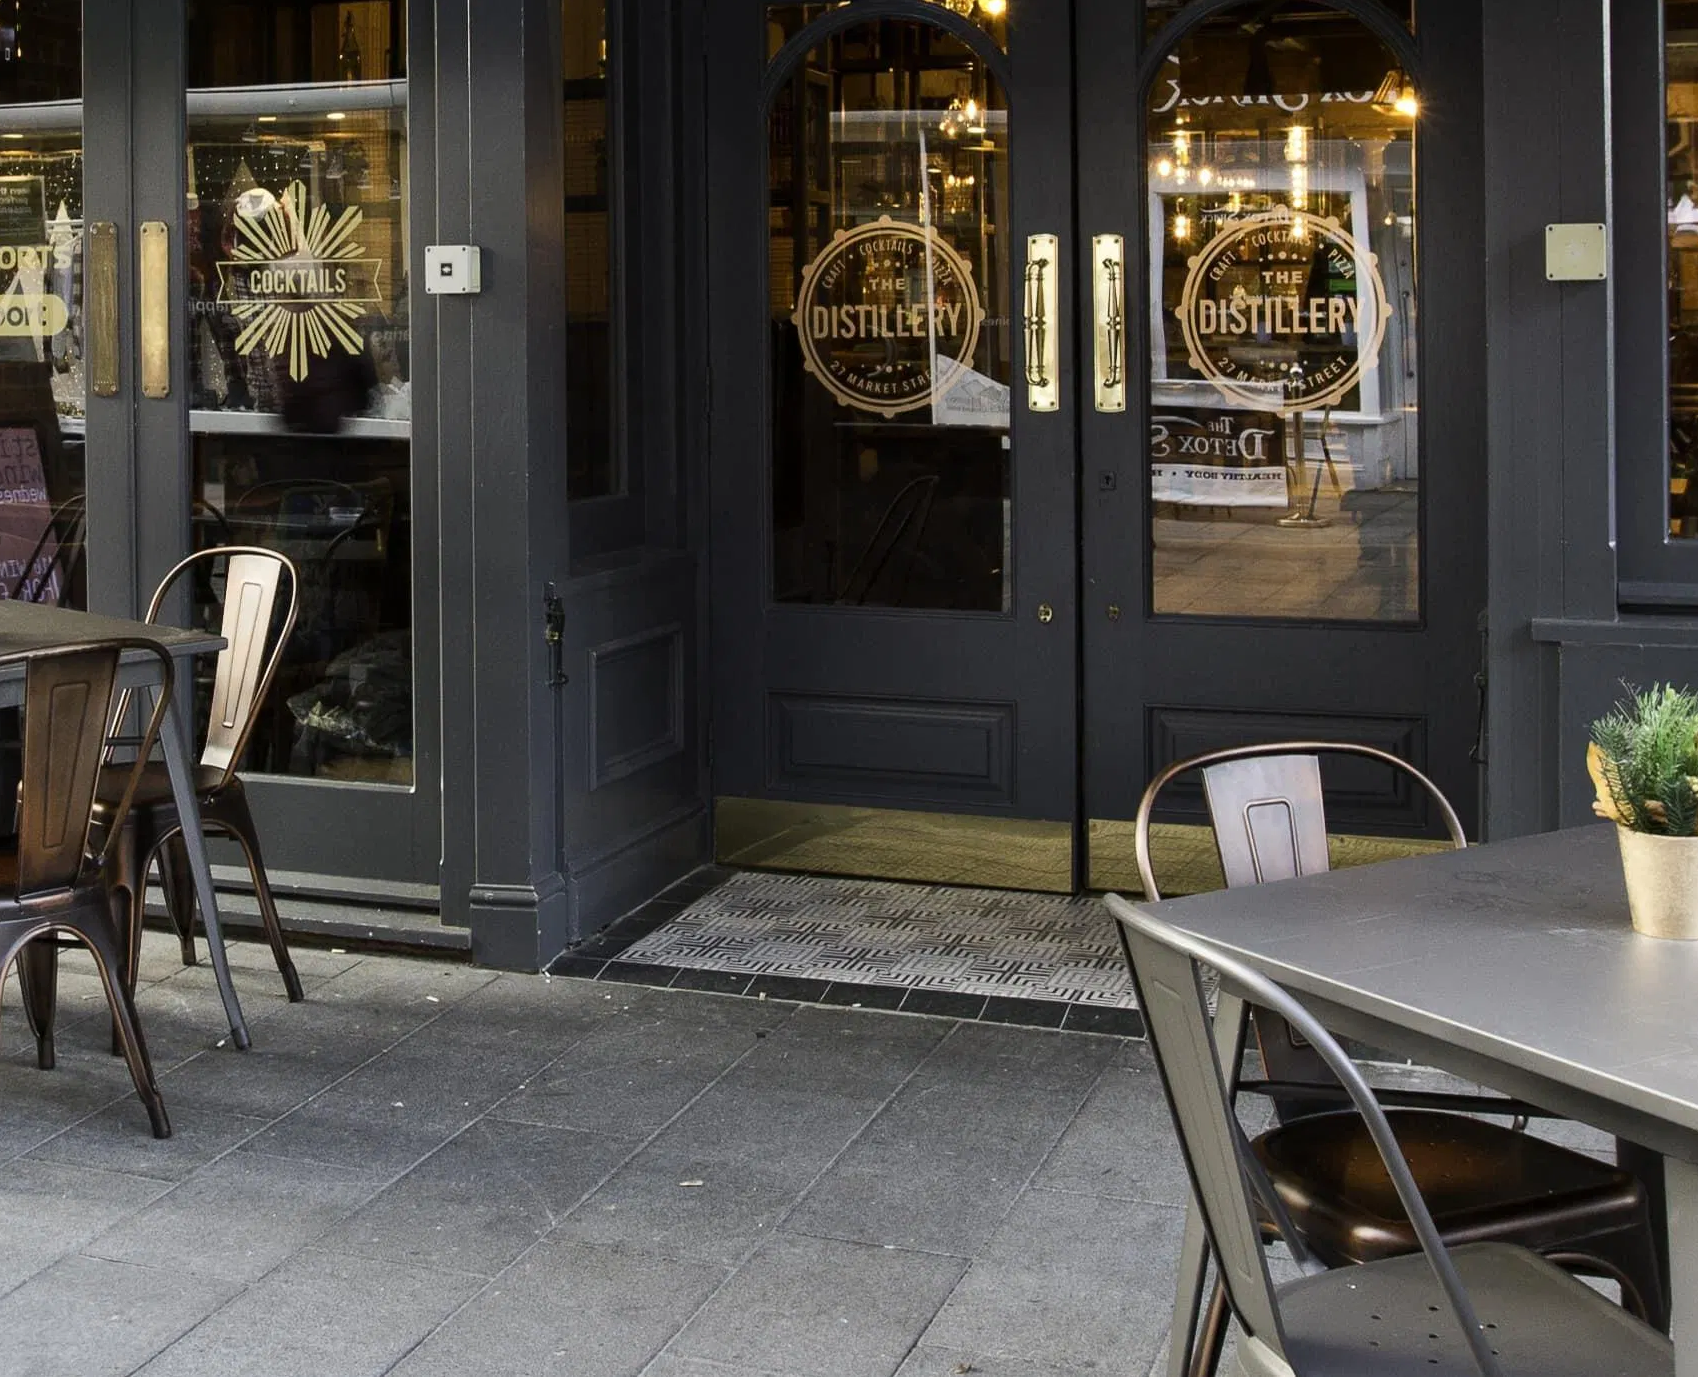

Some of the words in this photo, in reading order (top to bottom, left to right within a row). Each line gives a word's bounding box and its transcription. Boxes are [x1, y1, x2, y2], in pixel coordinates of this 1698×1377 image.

[859, 239, 914, 256] COCKTAILS
[822, 259, 846, 290] CRAFT
[1209, 250, 1237, 282] CRAFT
[1261, 270, 1304, 284] THE
[1327, 248, 1355, 280] PIZZA
[250, 268, 347, 294] COCKTAILS
[868, 277, 906, 291] THE
[813, 302, 962, 339] DISTILLERY
[1200, 297, 1366, 335] DISTILLERY
[830, 360, 846, 376] 27
[846, 374, 898, 393] MARKET
[1218, 357, 1236, 374] 27
[1299, 355, 1349, 390] STREET
